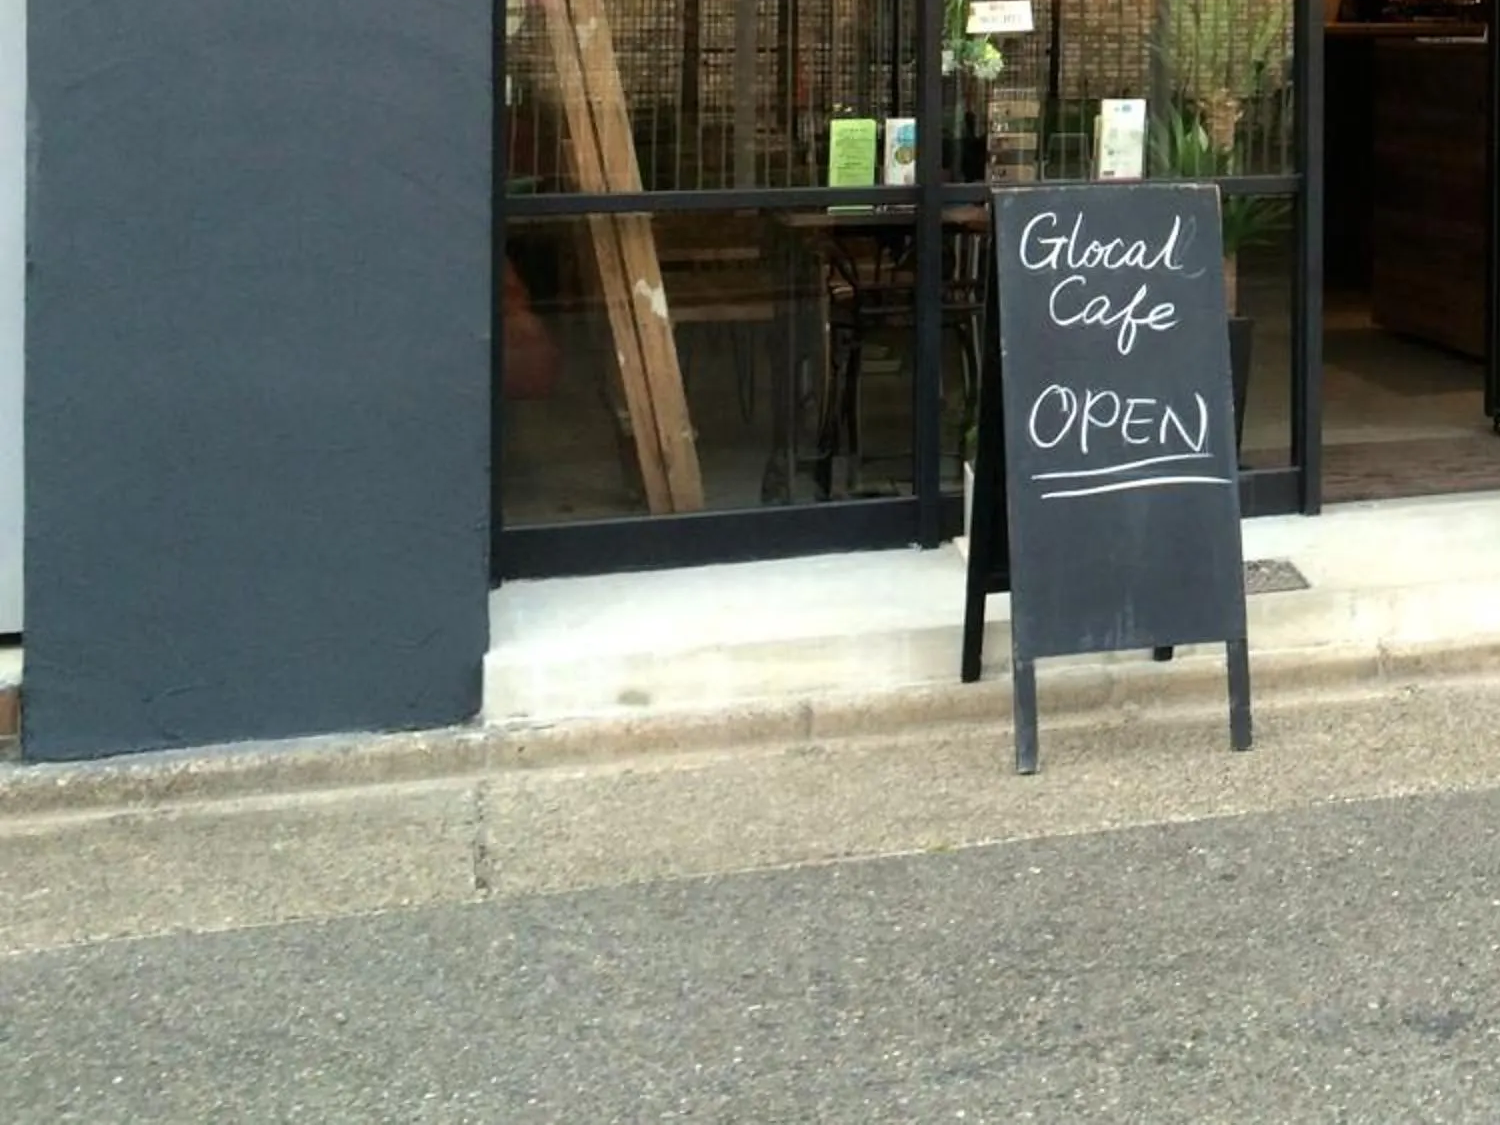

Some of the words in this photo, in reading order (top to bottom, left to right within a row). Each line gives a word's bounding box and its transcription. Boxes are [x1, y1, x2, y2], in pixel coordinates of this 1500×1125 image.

[1019, 211, 1184, 271] Glocal
[1048, 275, 1181, 355] Cafe
[1028, 383, 1208, 454] OPEN
